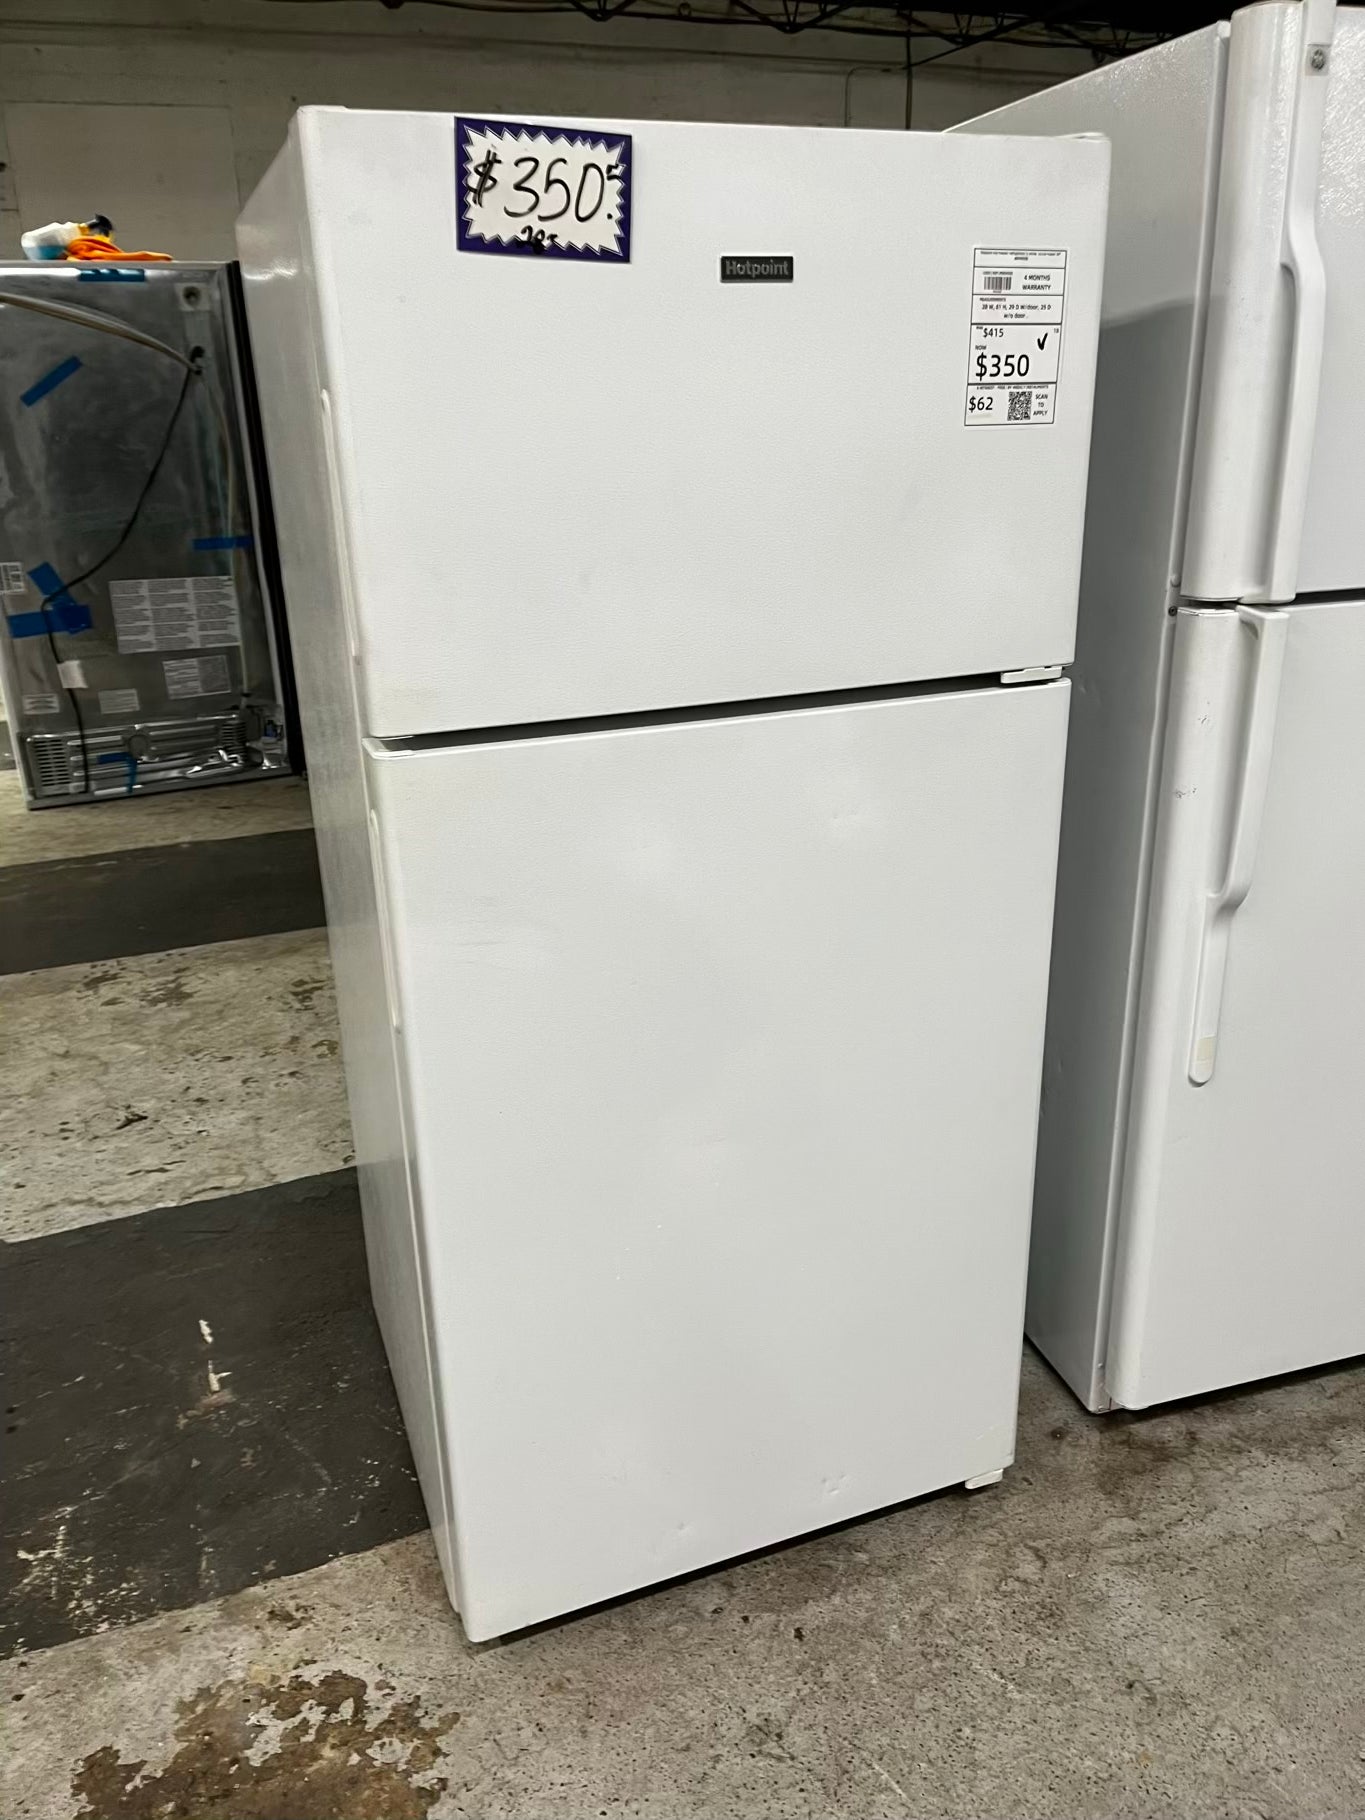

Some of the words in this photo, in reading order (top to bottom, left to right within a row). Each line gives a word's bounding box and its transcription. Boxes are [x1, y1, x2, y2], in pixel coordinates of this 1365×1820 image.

[725, 258, 789, 279] Hotpoint
[1028, 274, 1051, 282] MONTHS
[983, 328, 1004, 338] $415
[975, 352, 1030, 382] $350
[968, 395, 993, 413] $62
